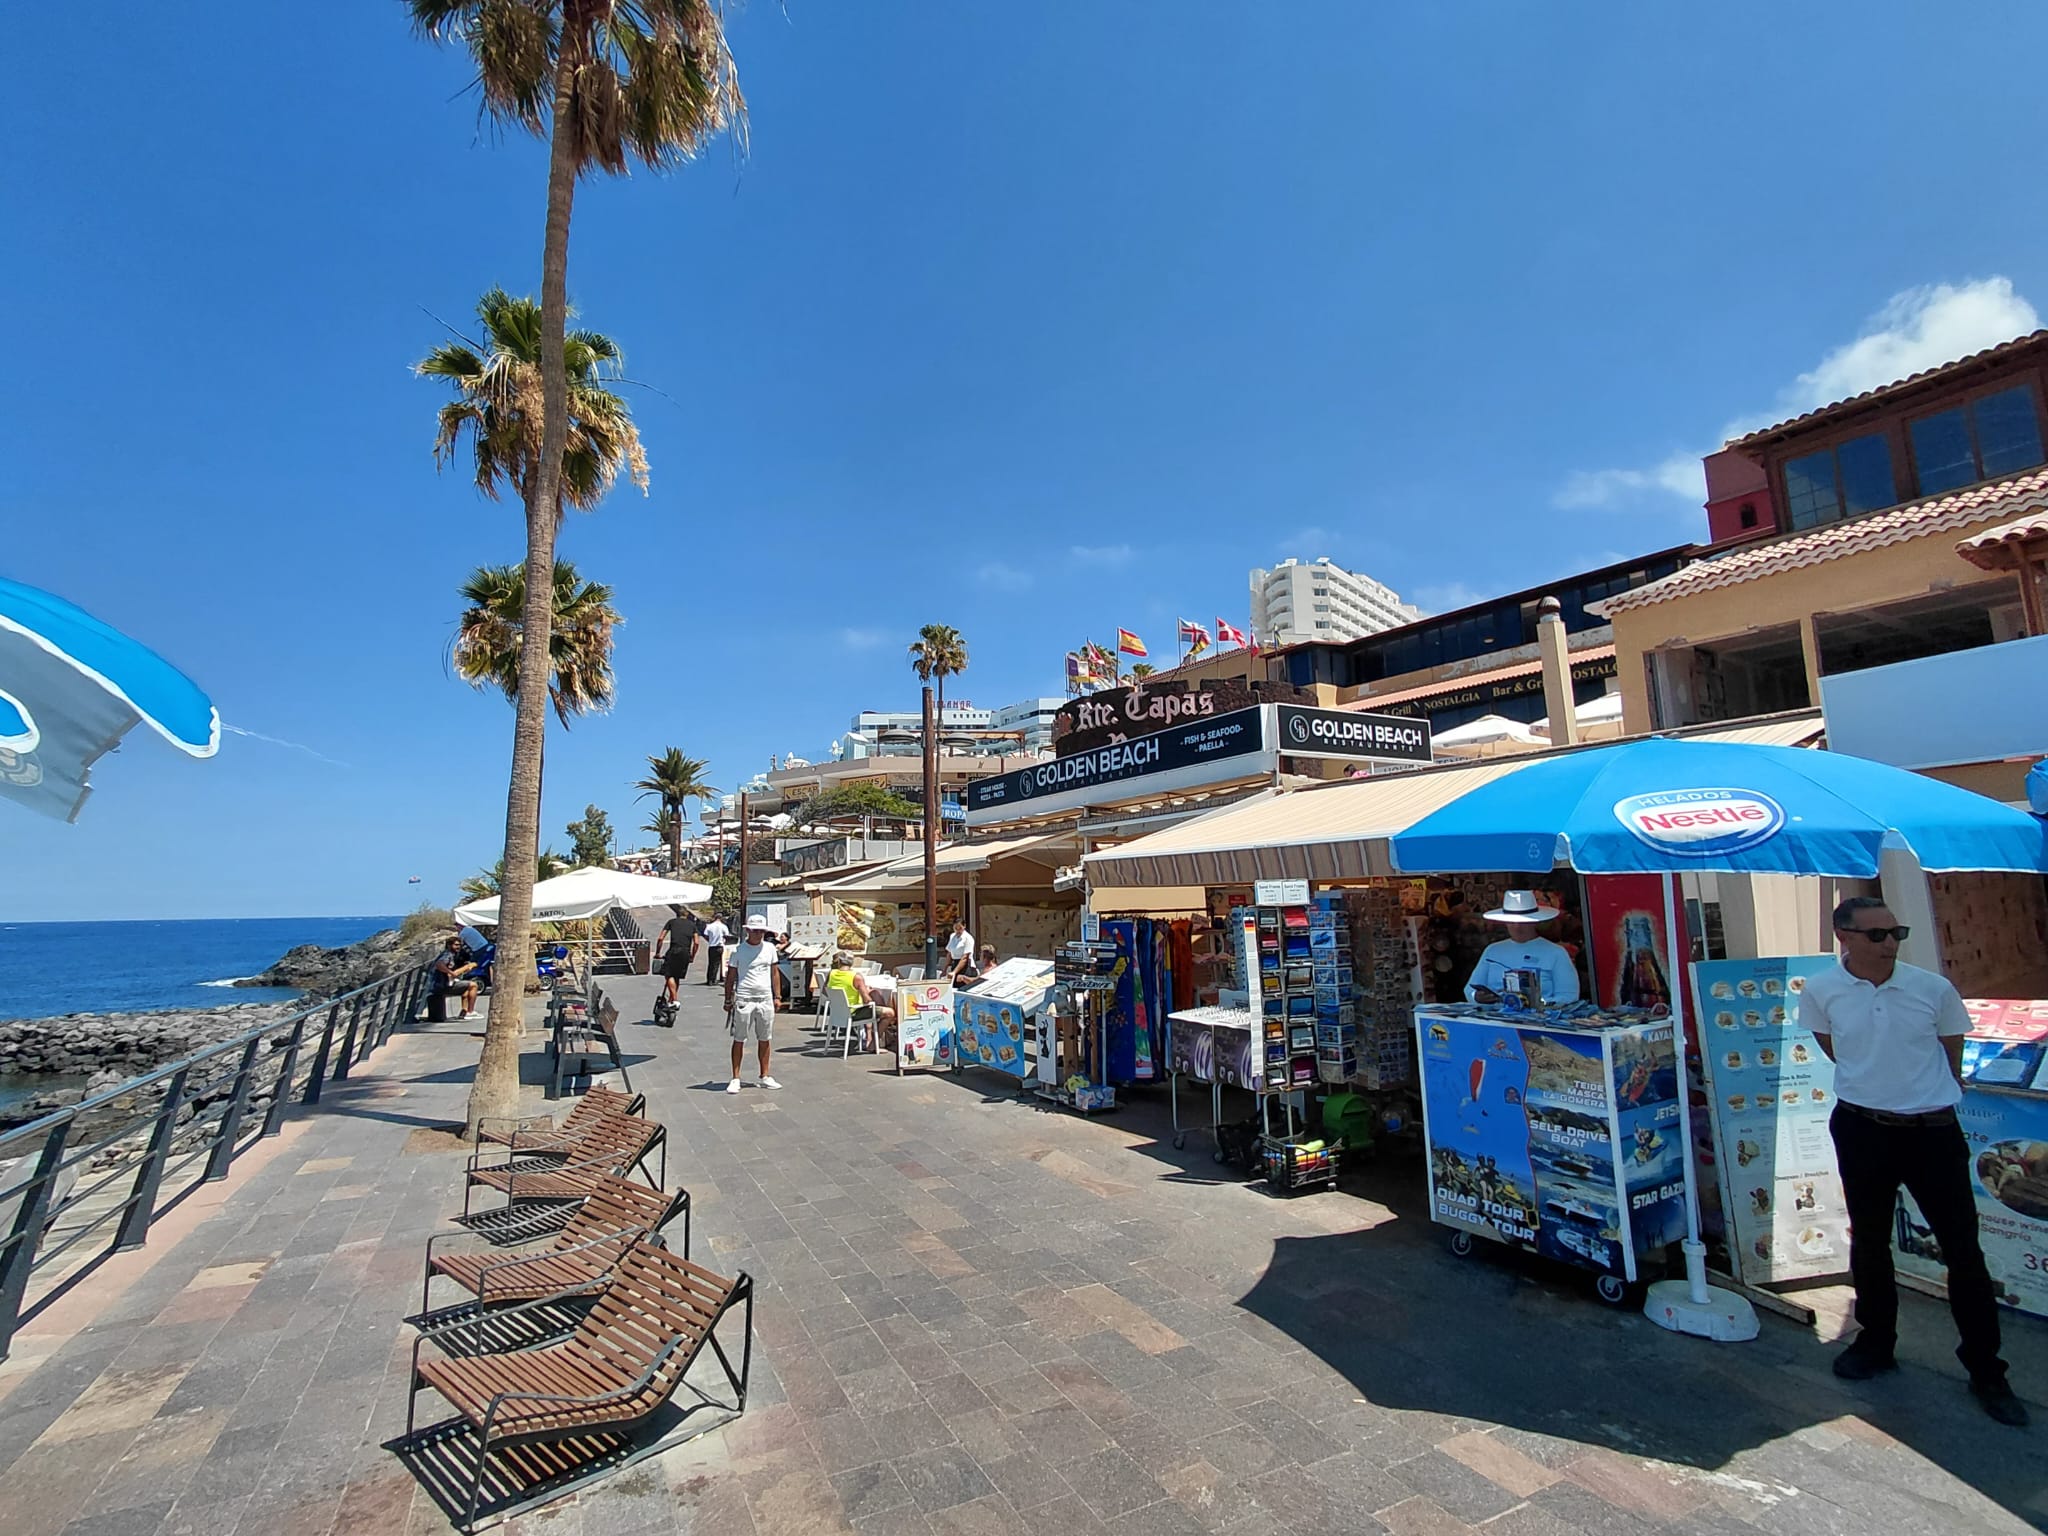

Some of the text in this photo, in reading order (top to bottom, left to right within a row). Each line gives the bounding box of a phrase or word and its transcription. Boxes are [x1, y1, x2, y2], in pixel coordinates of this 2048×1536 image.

[1573, 663, 1618, 679] OSTAL
[1492, 684, 1512, 697] Bar
[1514, 682, 1525, 693] &
[1075, 685, 1214, 732] Rte. Tapas
[1424, 692, 1480, 711] NOSTALGIA
[1391, 705, 1412, 716] Grill
[1184, 724, 1241, 745] FISH & SEAFOOD
[1311, 718, 1422, 746] GOLDEN BEACH
[1198, 739, 1225, 752] PAELLA
[1323, 738, 1414, 752] RESTAURANTE
[1036, 737, 1160, 787] GOLDEN BEACH
[1638, 791, 1732, 807] HELADOS
[1567, 1087, 1606, 1100] MASCA
[1573, 1080, 1605, 1092] TEIDE
[1542, 1091, 1606, 1109] LA GOMERA
[1529, 1119, 1609, 1143] SELF DRIVE
[1551, 1133, 1588, 1148] BOAT
[1437, 1187, 1525, 1221] QUAD TOUR
[1632, 1193, 1659, 1210] STAR
[1438, 1203, 1536, 1242] BUGGY TOUR
